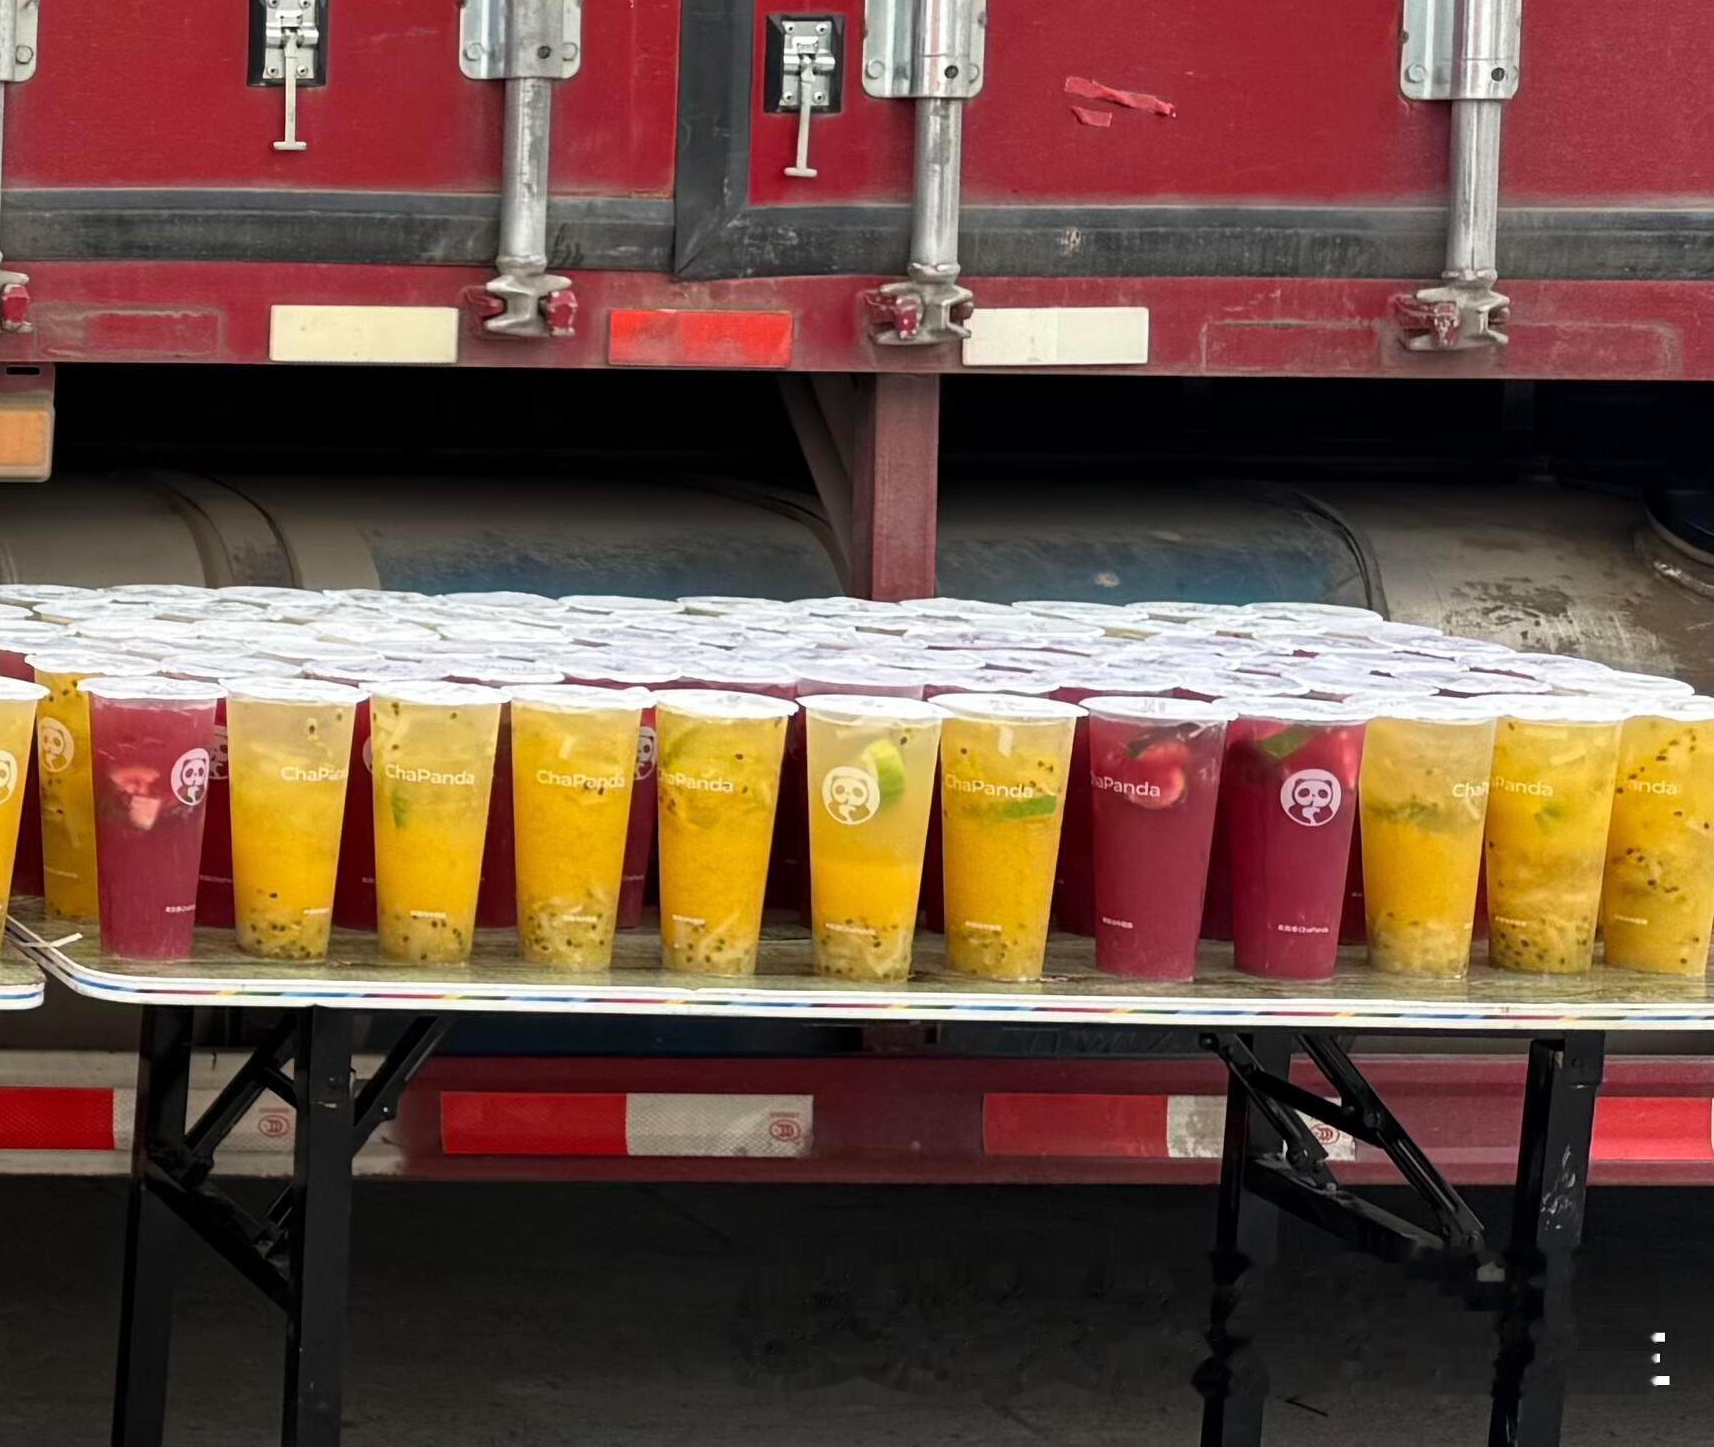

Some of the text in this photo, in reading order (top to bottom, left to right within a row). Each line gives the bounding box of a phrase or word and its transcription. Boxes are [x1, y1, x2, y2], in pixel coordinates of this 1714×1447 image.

[384, 763, 476, 786] ChaPanda
[535, 769, 626, 790] ChaPanda
[944, 772, 1035, 799] ChaPanda
